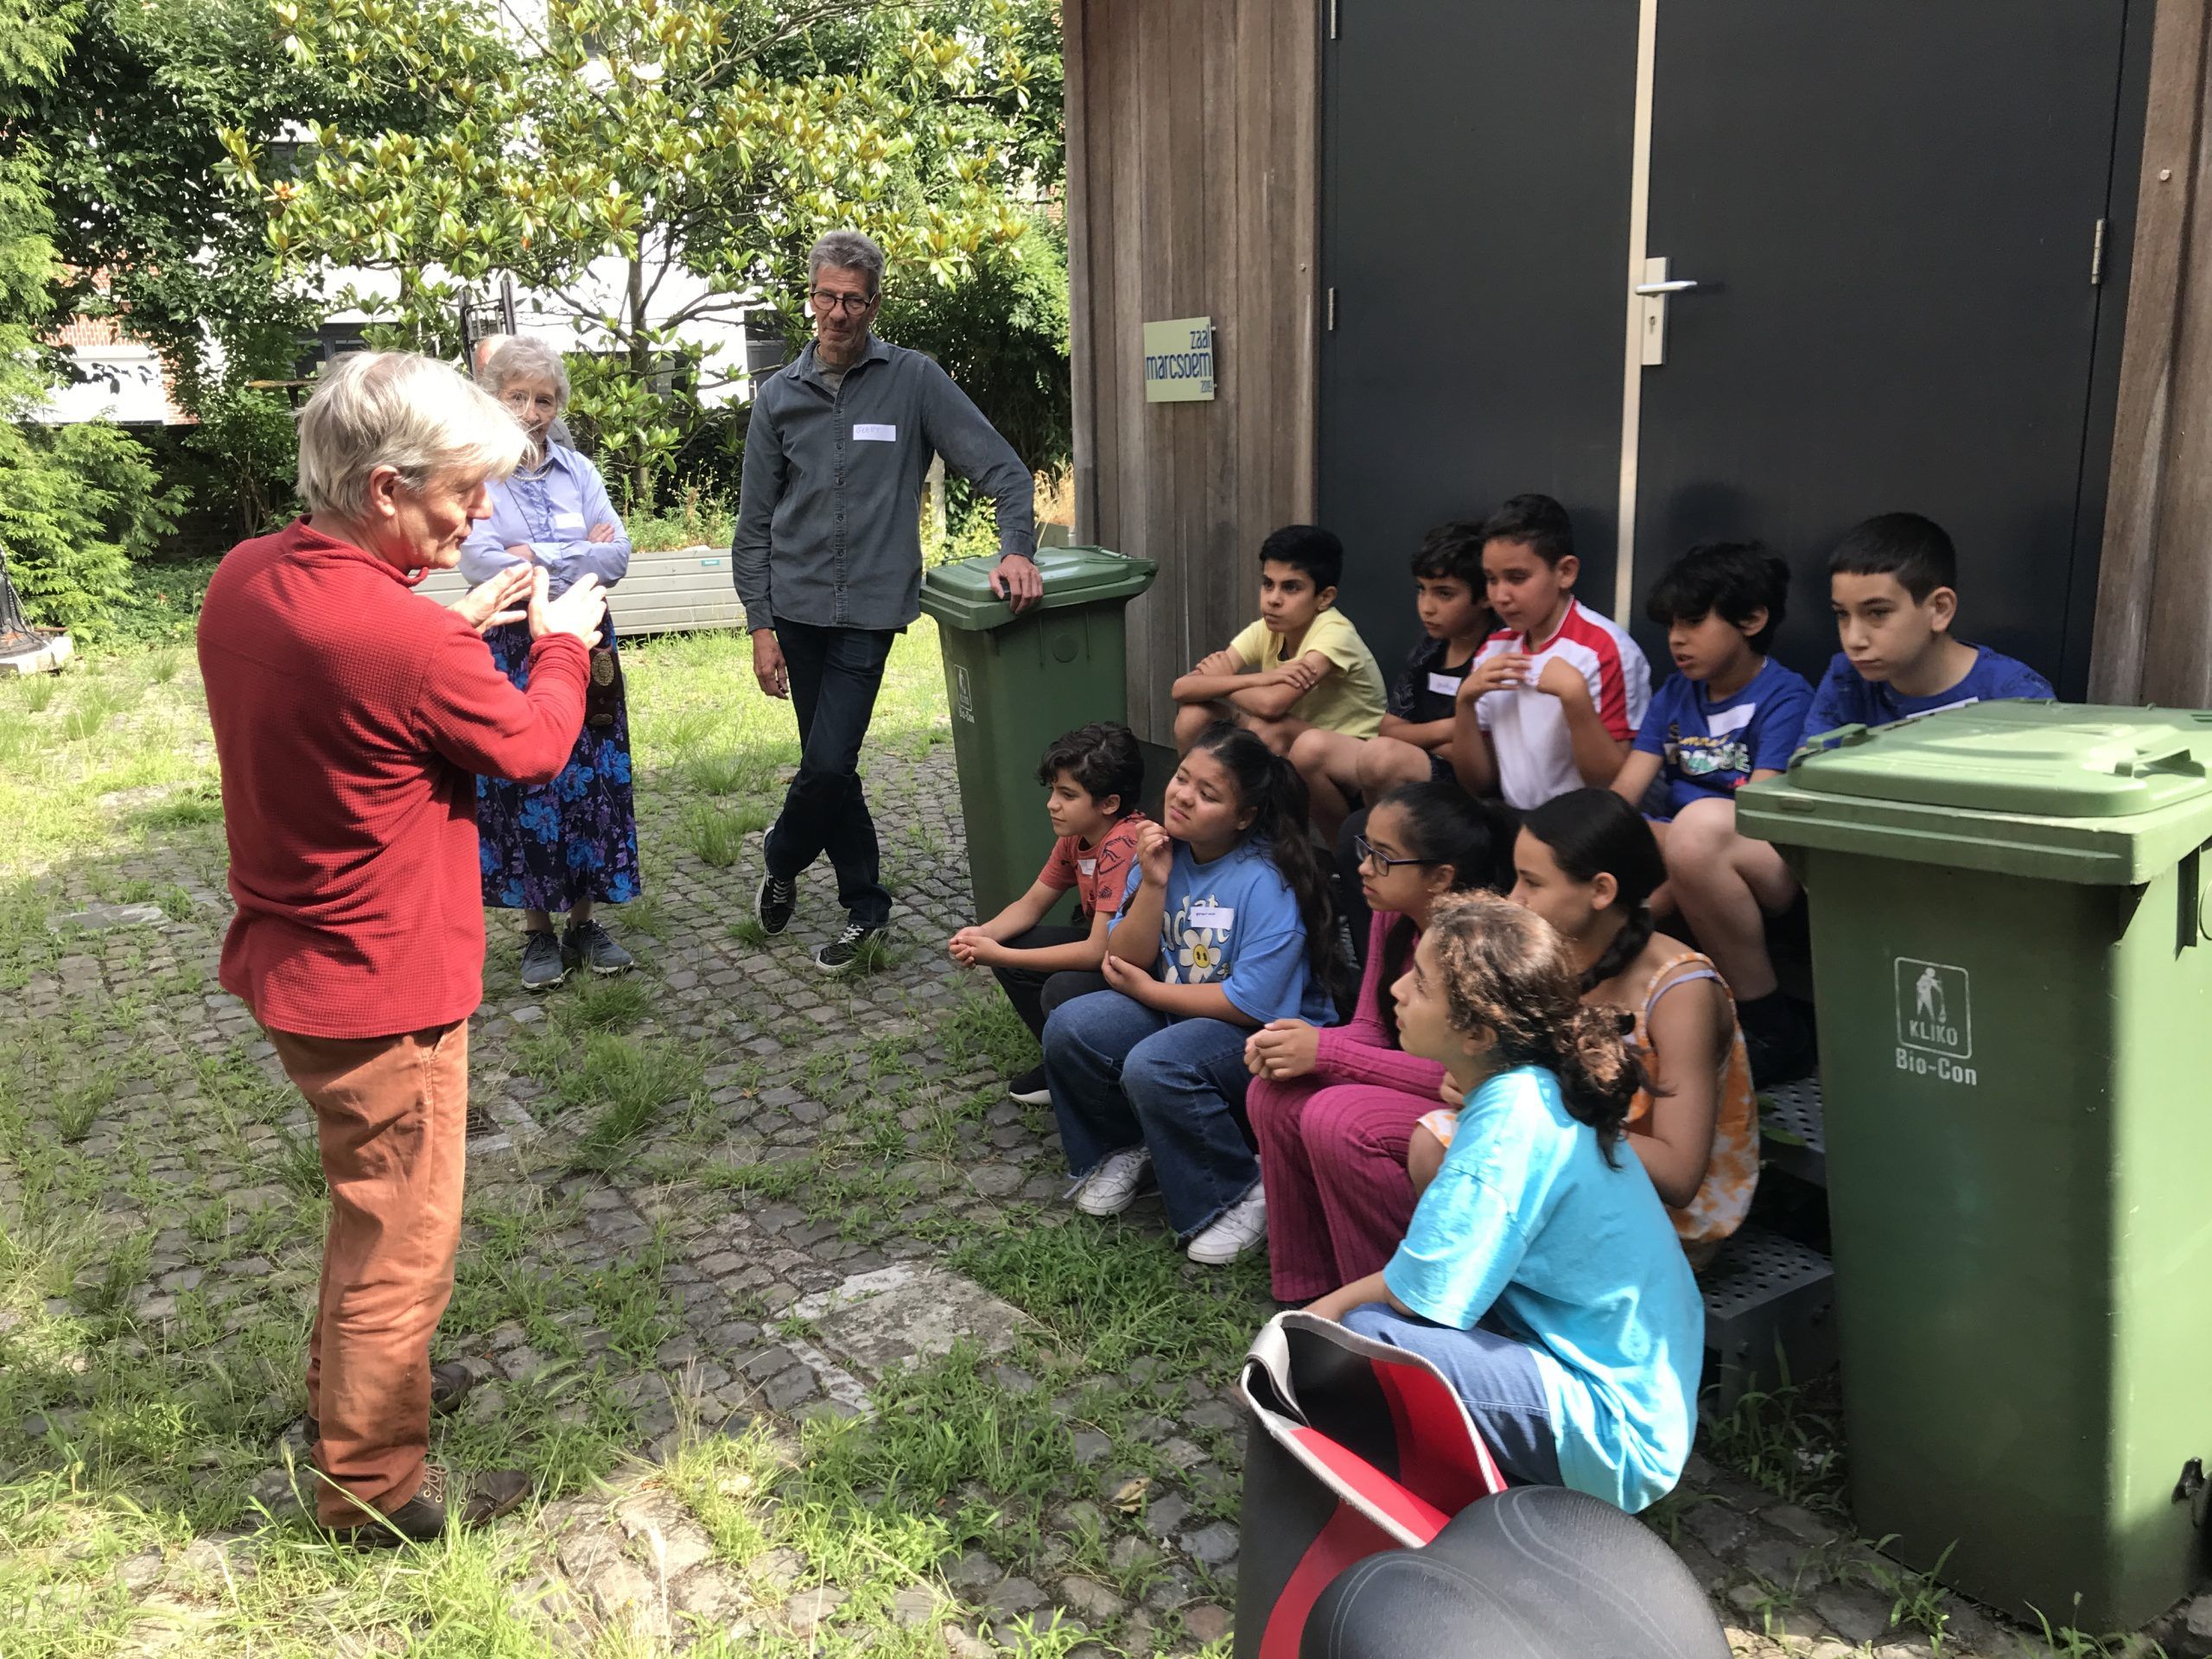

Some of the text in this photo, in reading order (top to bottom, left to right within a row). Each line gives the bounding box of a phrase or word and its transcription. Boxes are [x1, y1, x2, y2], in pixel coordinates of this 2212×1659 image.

[1190, 324, 1211, 349] zaal
[1146, 353, 1211, 380] marcsoem
[1909, 1019, 1958, 1046] KLIKO
[1895, 1046, 1977, 1086] Bio-Con
